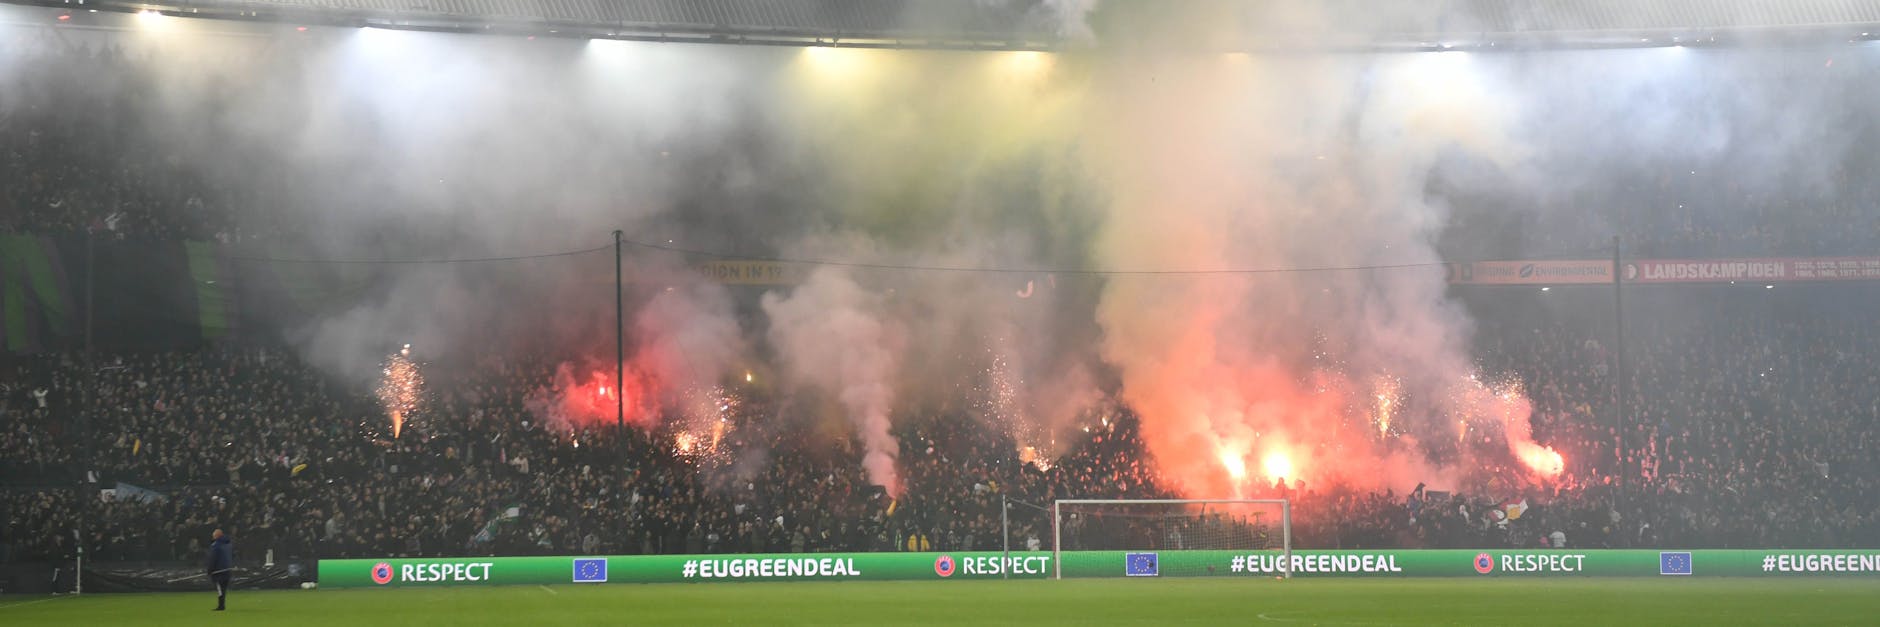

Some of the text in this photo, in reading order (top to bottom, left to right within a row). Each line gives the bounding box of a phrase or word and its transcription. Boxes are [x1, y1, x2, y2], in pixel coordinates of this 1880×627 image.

[1644, 263, 1785, 279] LANDSKAMPIOEN
[682, 557, 861, 578] #EUGREENDEAL
[963, 556, 1049, 574] RESPECT
[1230, 554, 1402, 572] #EUGREENDEAL
[1501, 554, 1586, 571] RESPECT
[401, 562, 493, 582] RESPECT
